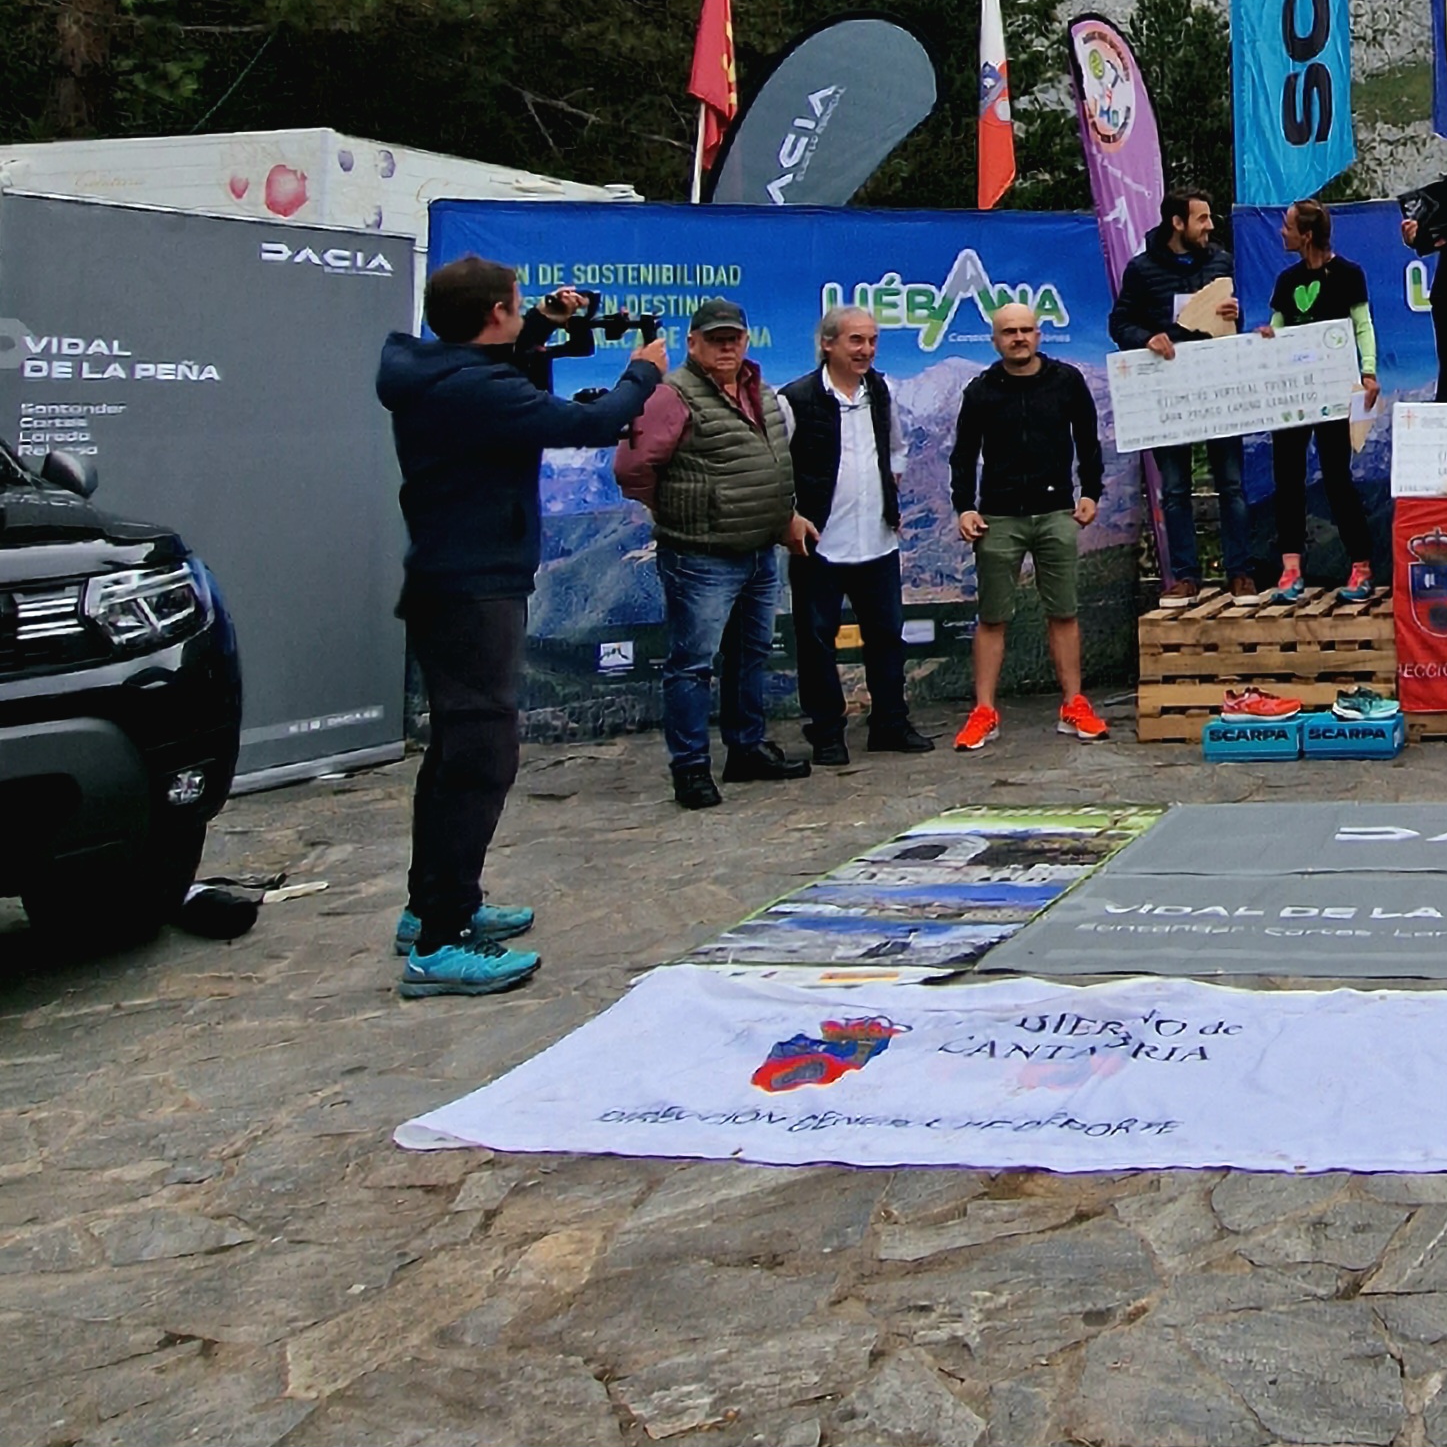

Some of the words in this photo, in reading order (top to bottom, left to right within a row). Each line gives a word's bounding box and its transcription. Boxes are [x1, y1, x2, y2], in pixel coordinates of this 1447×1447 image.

[260, 242, 394, 272] DACIA
[539, 264, 566, 285] DE
[572, 263, 742, 286] SOSTENIBILIDAD
[23, 336, 132, 356] VIDAL
[23, 361, 73, 379] DE
[81, 361, 126, 380] LA
[134, 360, 221, 381] PEÑA
[21, 403, 127, 415] Santander
[20, 431, 91, 443] Laredo
[1209, 728, 1290, 743] SCARPA
[1308, 727, 1388, 741] SCARPA
[1104, 903, 1265, 917] VIDAL
[1279, 905, 1358, 919] DE
[1369, 906, 1444, 919] LA
